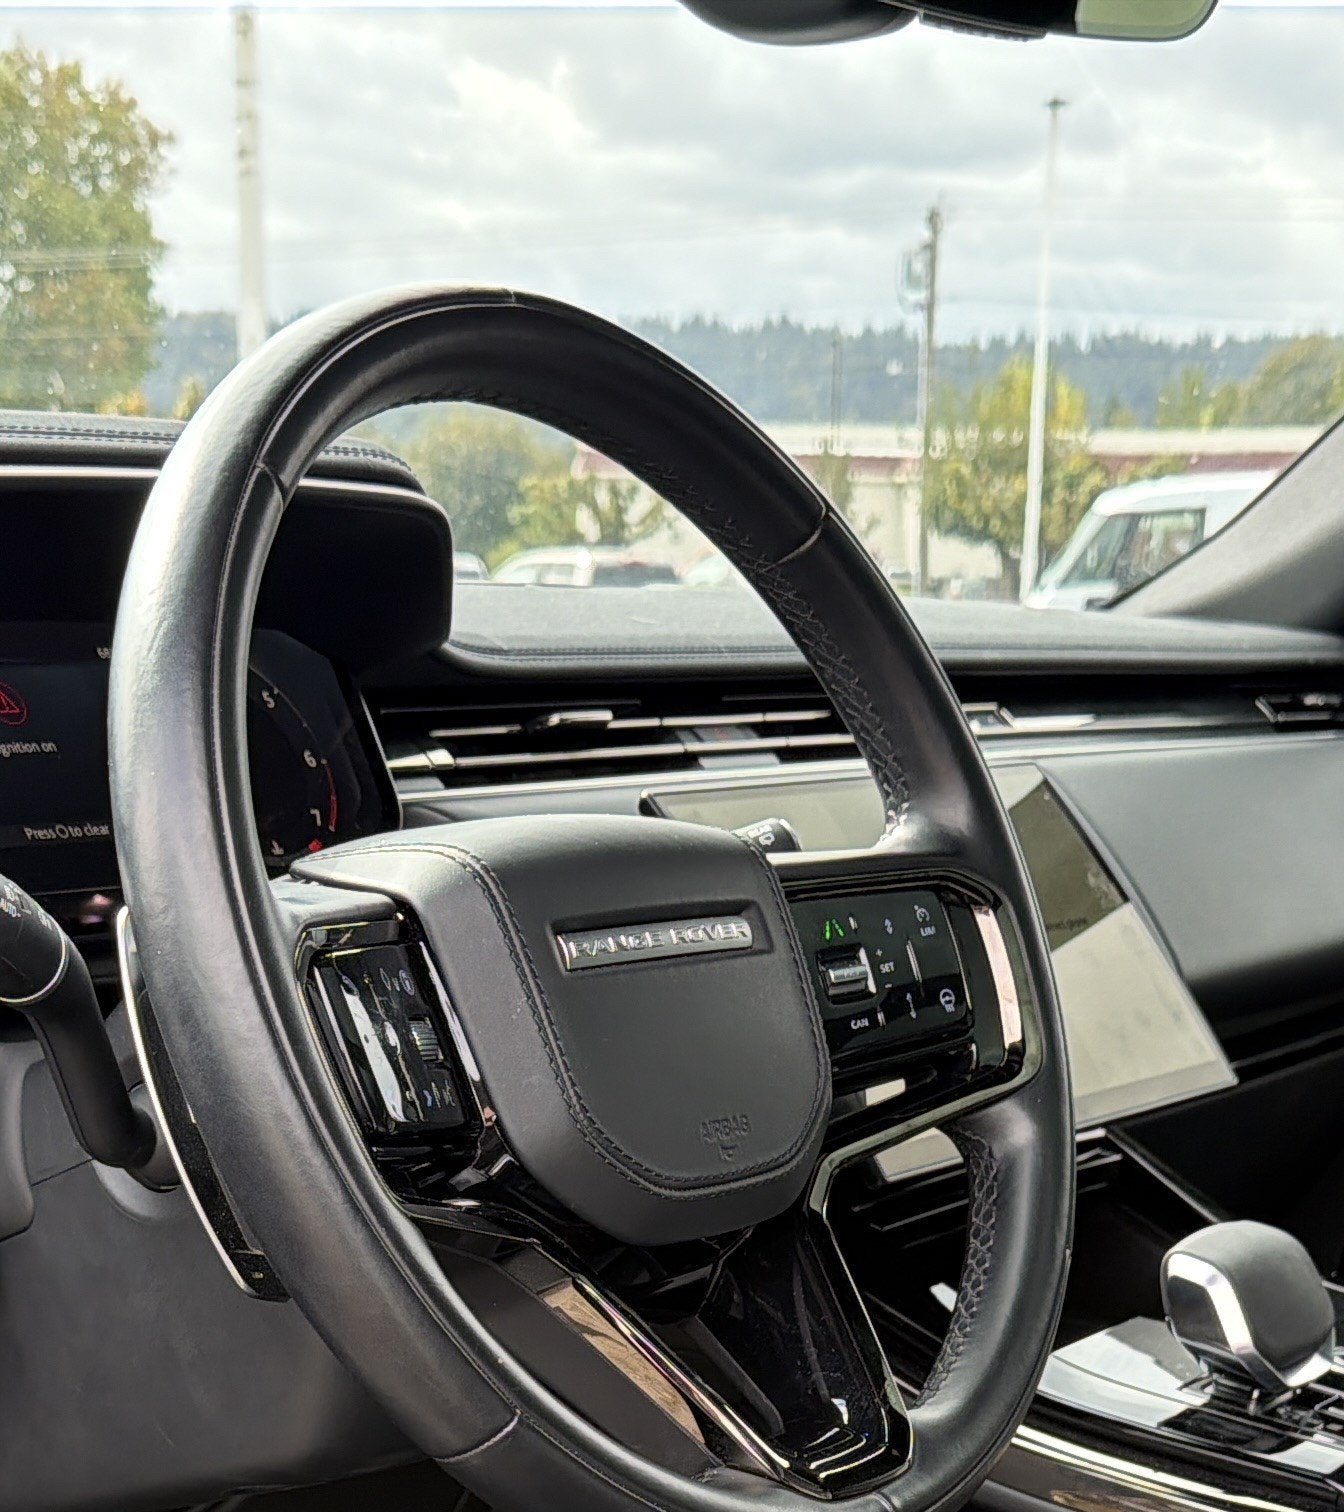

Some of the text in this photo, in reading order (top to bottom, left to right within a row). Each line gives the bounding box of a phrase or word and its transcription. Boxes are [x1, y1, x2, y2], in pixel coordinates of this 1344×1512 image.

[261, 689, 275, 709] 5
[41, 742, 58, 753] on
[303, 750, 317, 768] 6
[310, 808, 321, 827] 7
[24, 823, 110, 840] Press to clear
[568, 922, 748, 959] RANGE ROVER
[879, 961, 895, 974] SET
[850, 1017, 869, 1030] CAN
